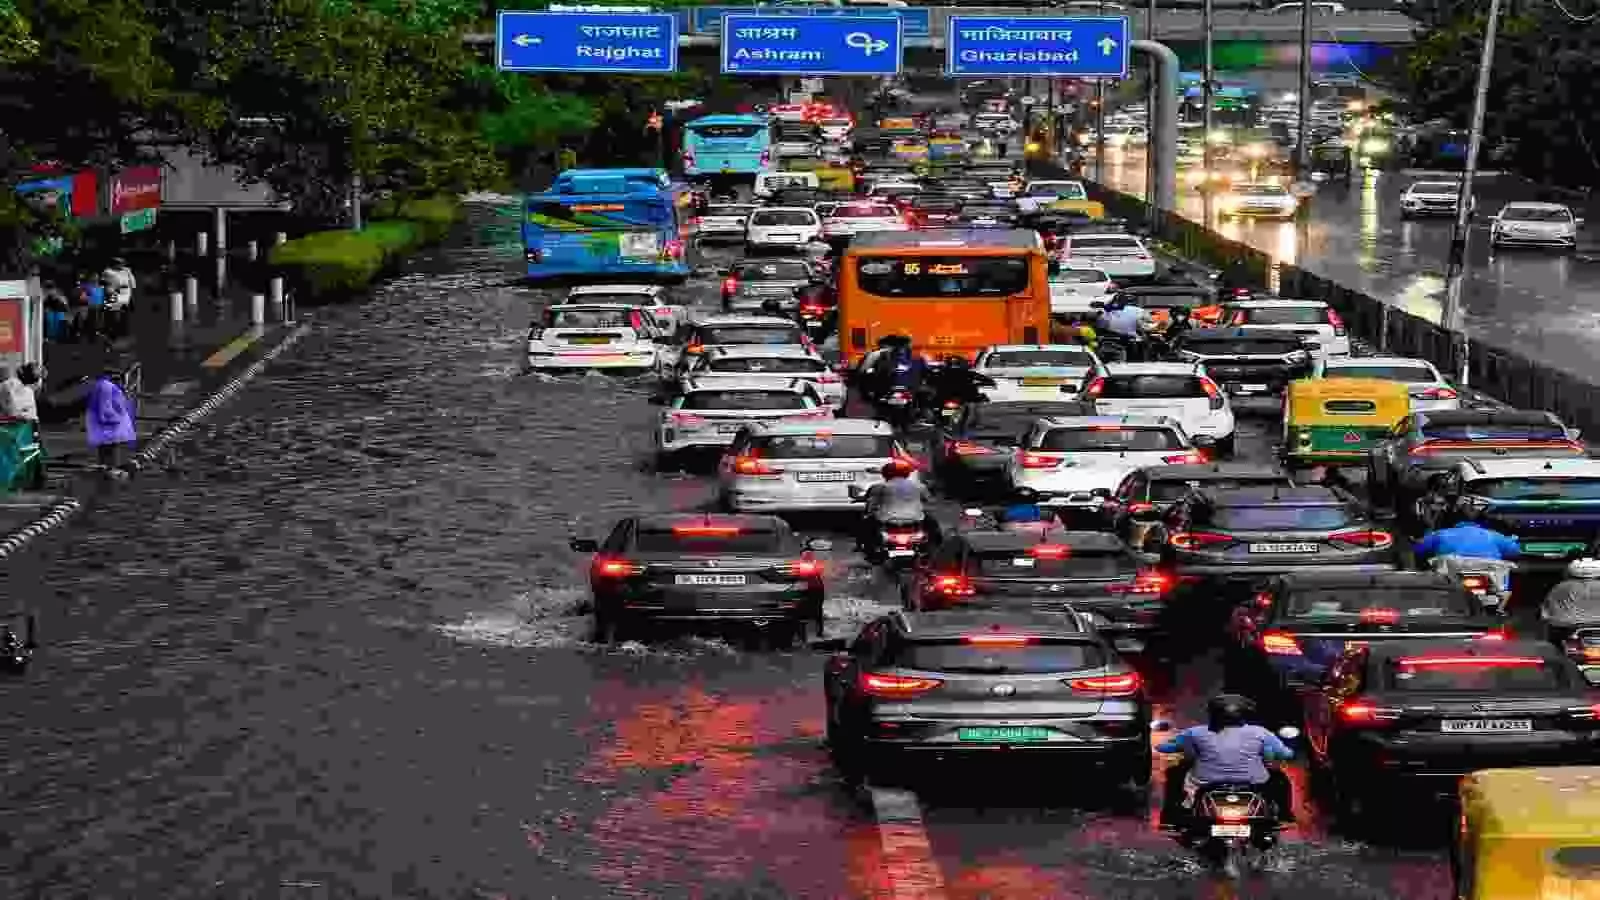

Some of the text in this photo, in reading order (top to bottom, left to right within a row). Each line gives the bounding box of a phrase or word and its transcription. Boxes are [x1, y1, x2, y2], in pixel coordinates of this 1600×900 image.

[579, 24, 661, 39] राजघाट
[735, 27, 798, 40] आश्रम
[576, 45, 663, 60] Rajghat
[734, 47, 822, 60] Ashram
[959, 49, 1079, 63] Ghaziabad
